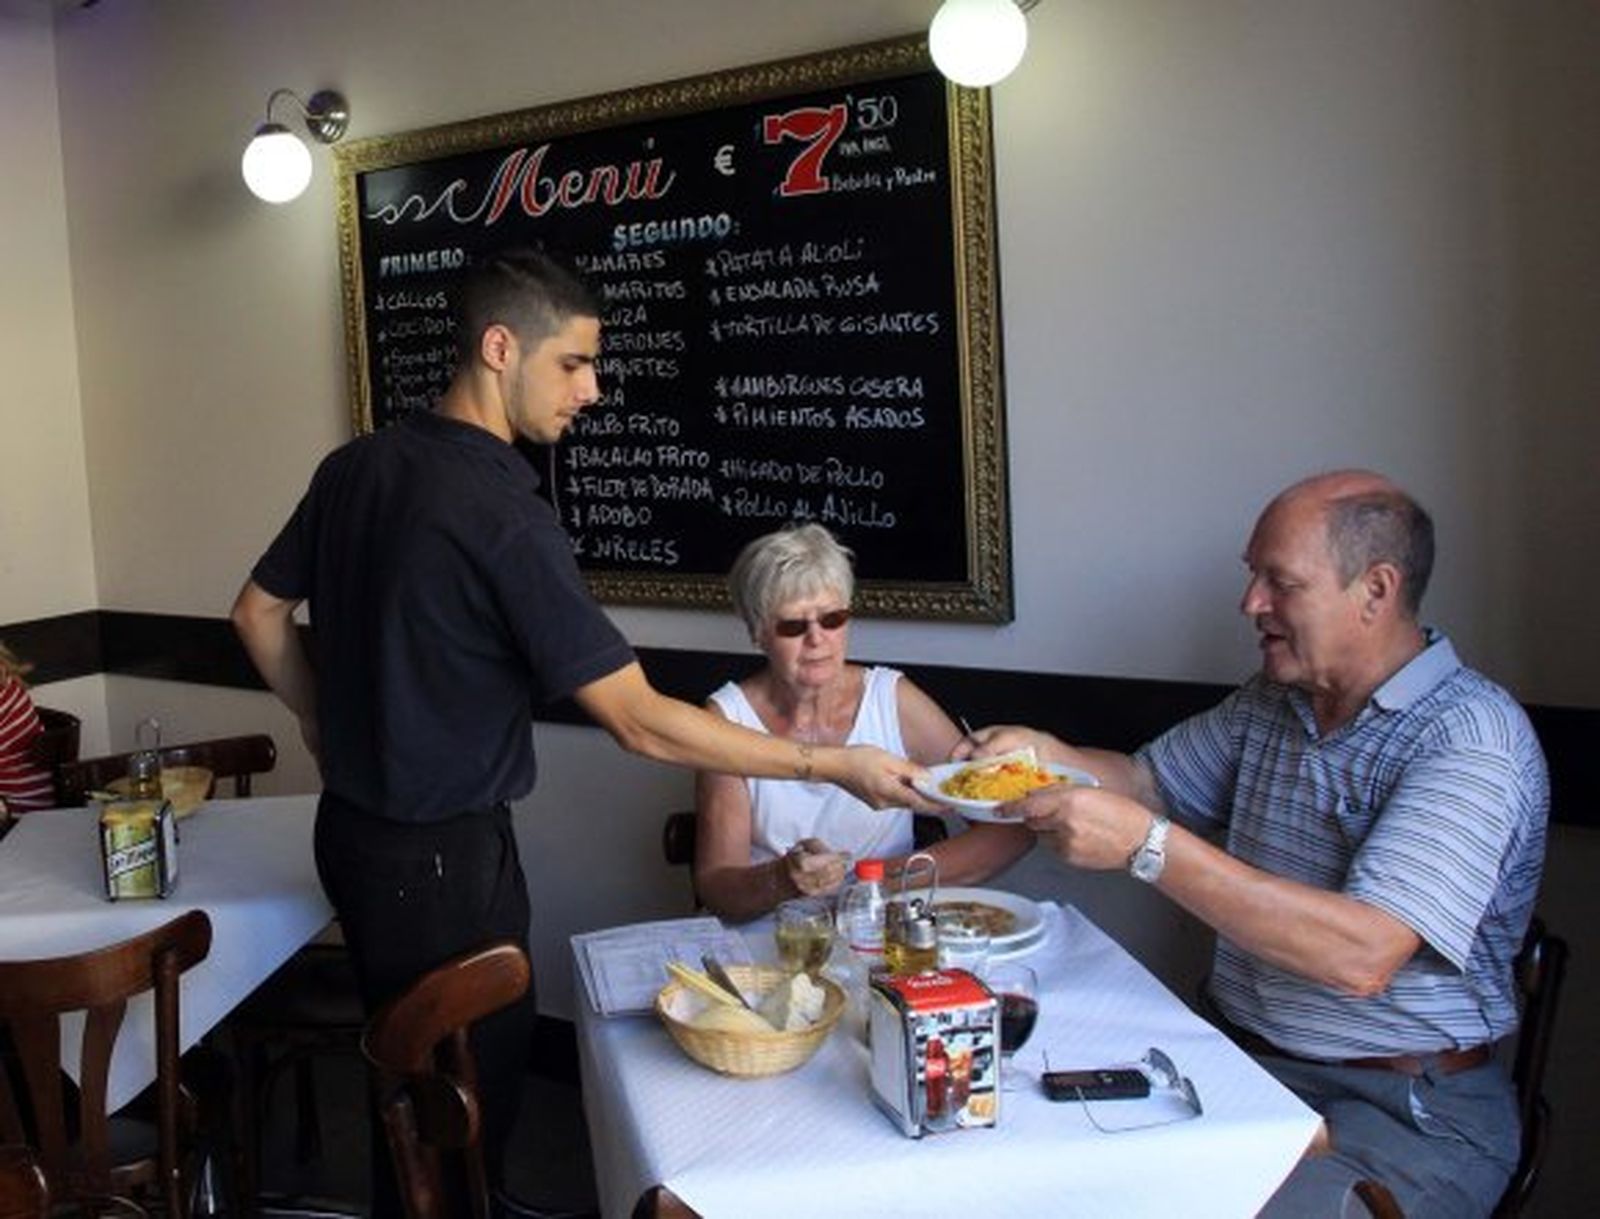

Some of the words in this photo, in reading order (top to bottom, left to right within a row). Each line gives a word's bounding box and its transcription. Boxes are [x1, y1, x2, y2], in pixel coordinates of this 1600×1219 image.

[714, 145, 736, 176] €
[763, 104, 848, 196] 7
[846, 404, 926, 430] ASADOS
[656, 444, 711, 468] FRITO
[588, 503, 653, 528] ADOBO
